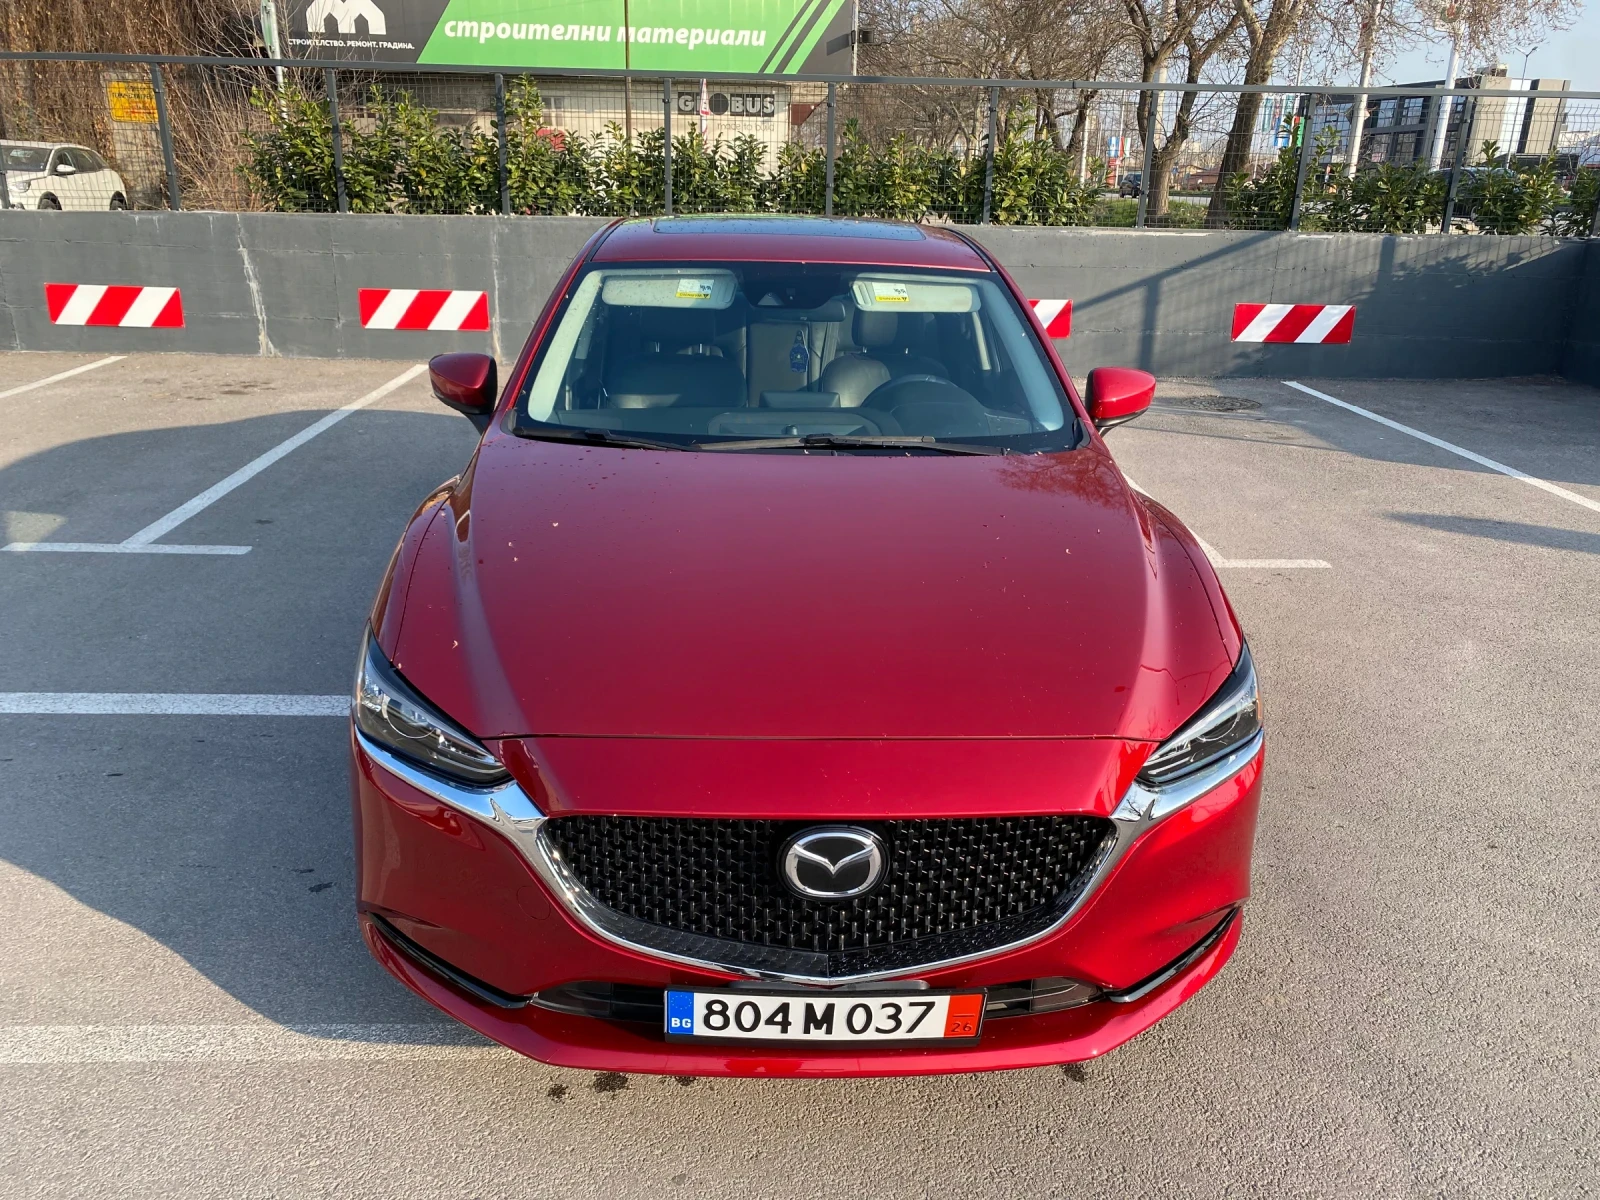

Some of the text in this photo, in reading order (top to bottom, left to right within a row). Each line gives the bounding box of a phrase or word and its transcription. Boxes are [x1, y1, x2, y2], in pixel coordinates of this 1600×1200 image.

[444, 20, 767, 51] строителни материали
[379, 41, 415, 50] ГРАДИНА.
[671, 1017, 692, 1029] BG
[703, 999, 936, 1035] 804 M 037
[950, 1021, 972, 1033] 26
